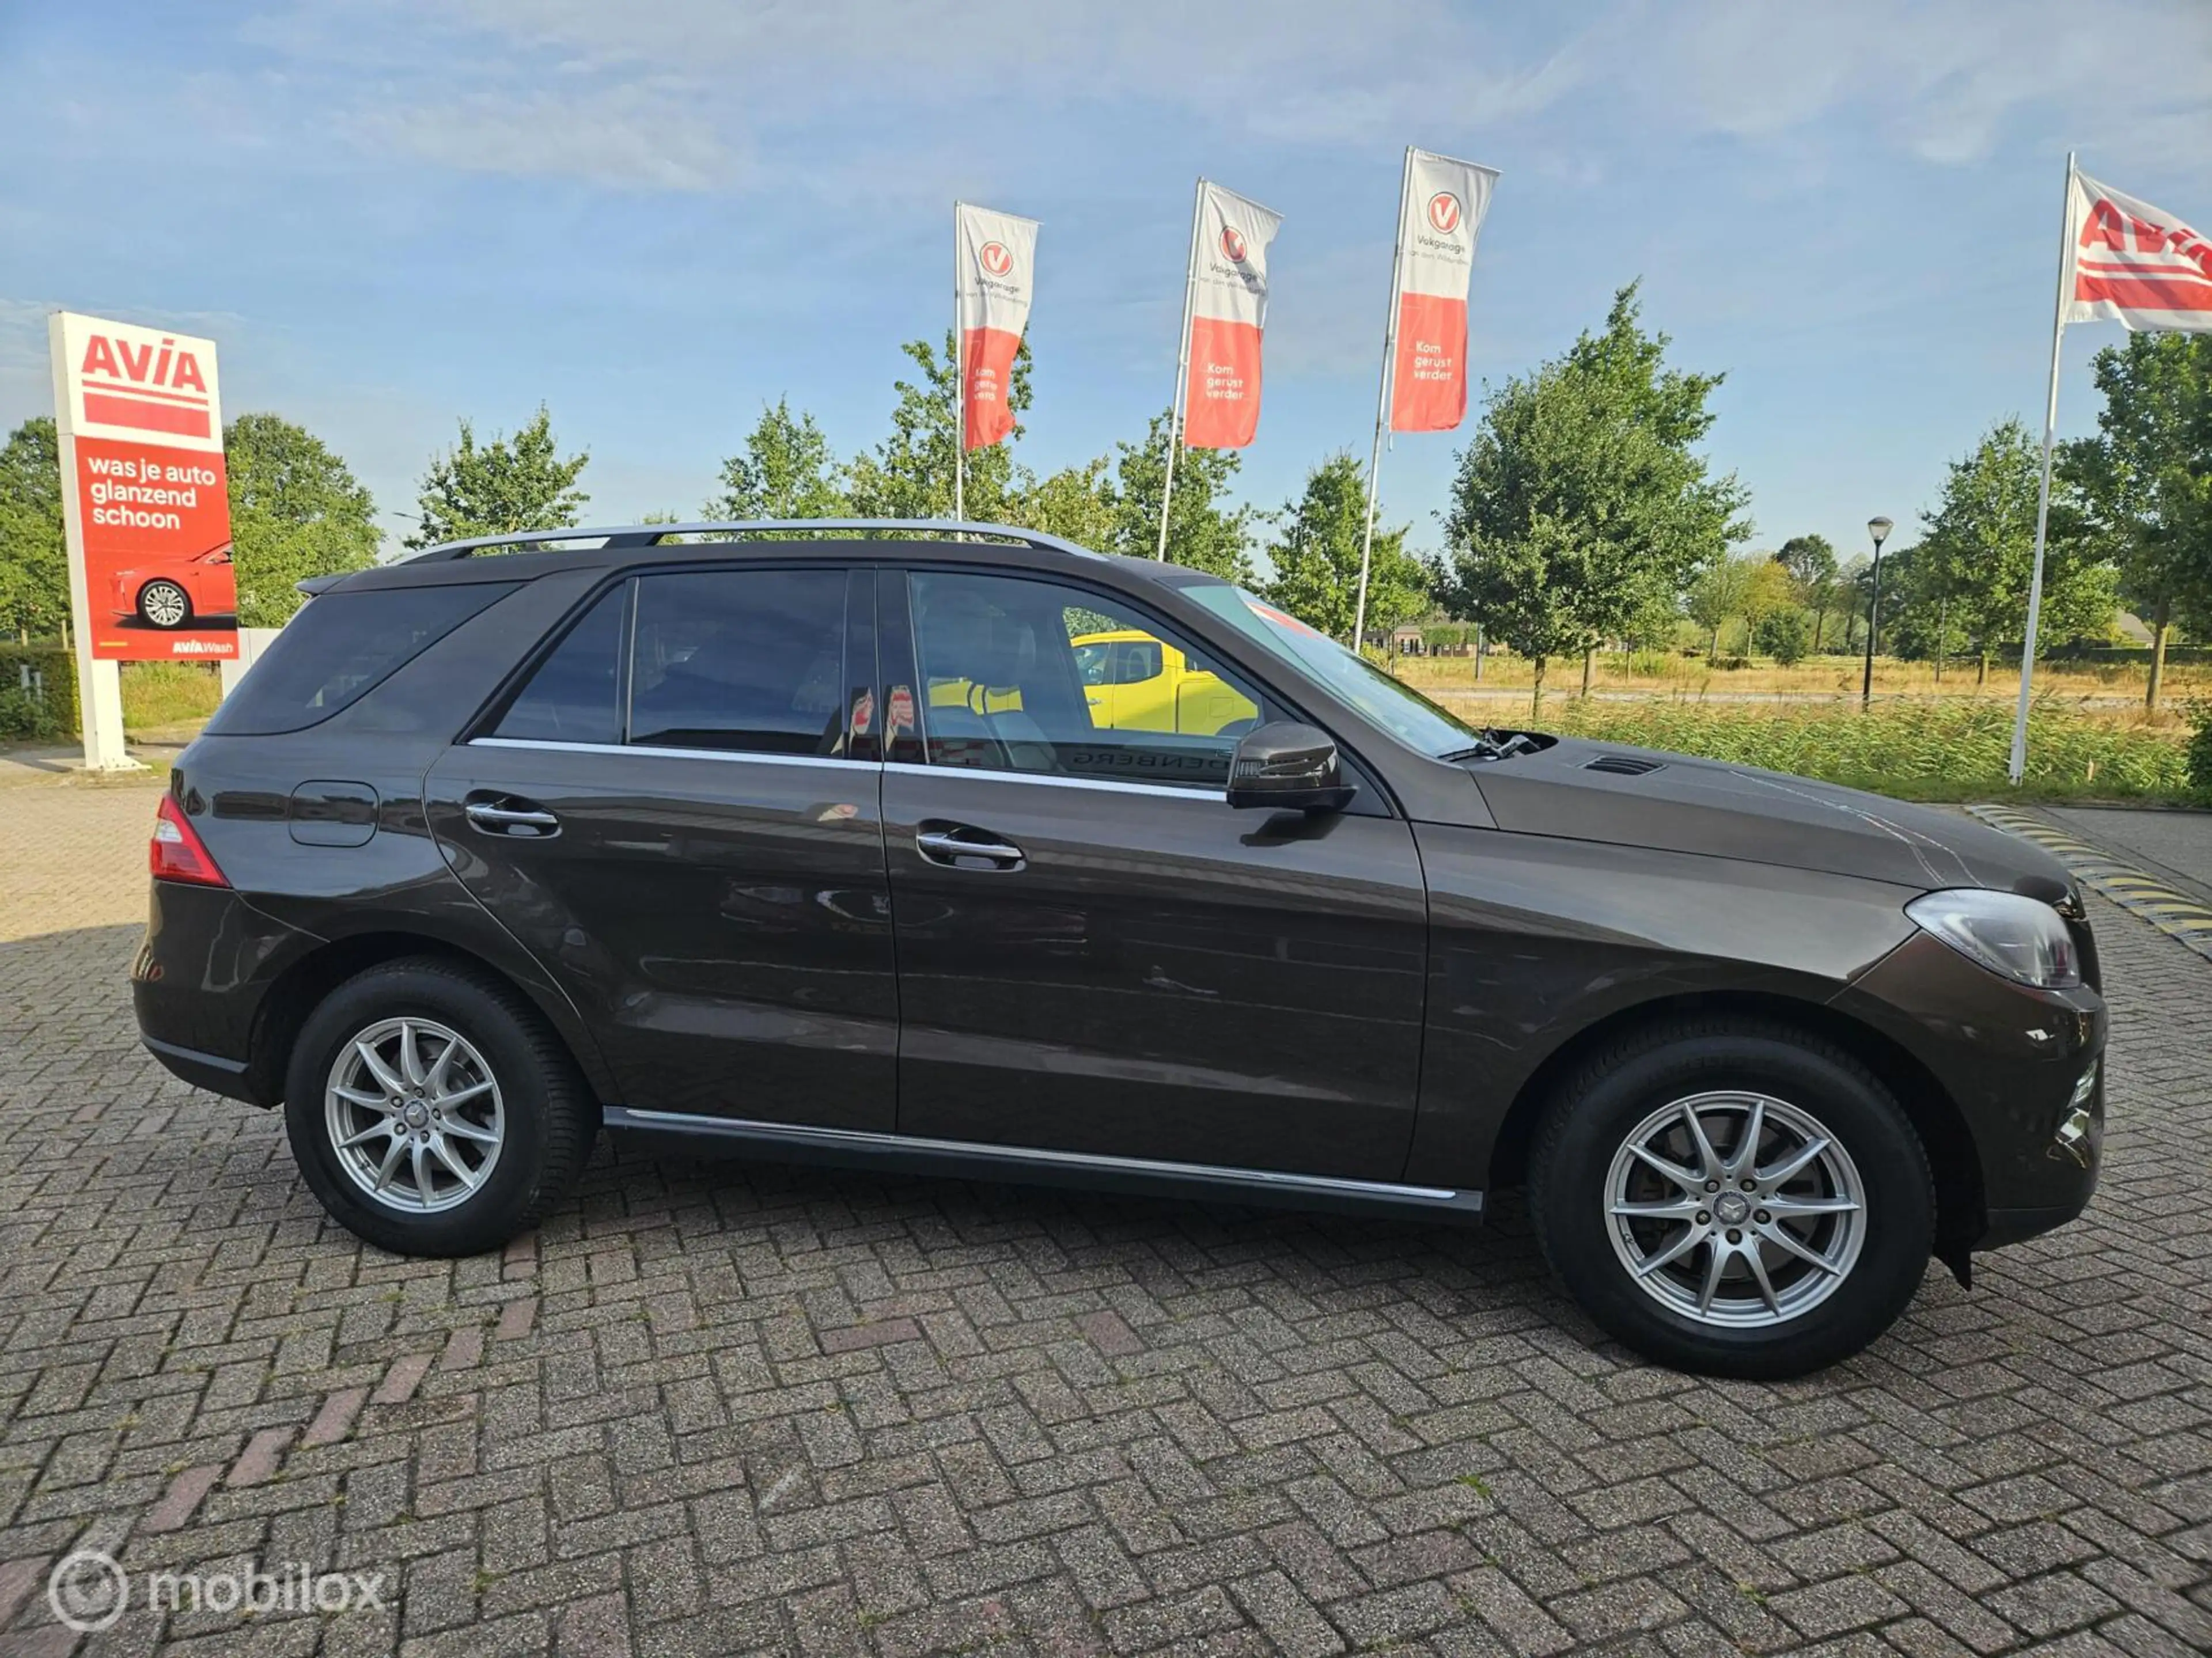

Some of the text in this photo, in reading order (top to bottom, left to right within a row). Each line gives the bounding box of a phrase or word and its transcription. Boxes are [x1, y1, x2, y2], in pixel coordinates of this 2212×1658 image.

[1416, 340, 1441, 355] Kom
[1207, 362, 1234, 375] Kom
[1414, 356, 1452, 370] gerust
[1414, 370, 1452, 382] verder
[1206, 377, 1244, 392] gerust
[1206, 389, 1244, 400] verder
[88, 456, 217, 487] was je auto
[90, 479, 197, 507] glanzend
[93, 504, 180, 530] schoon
